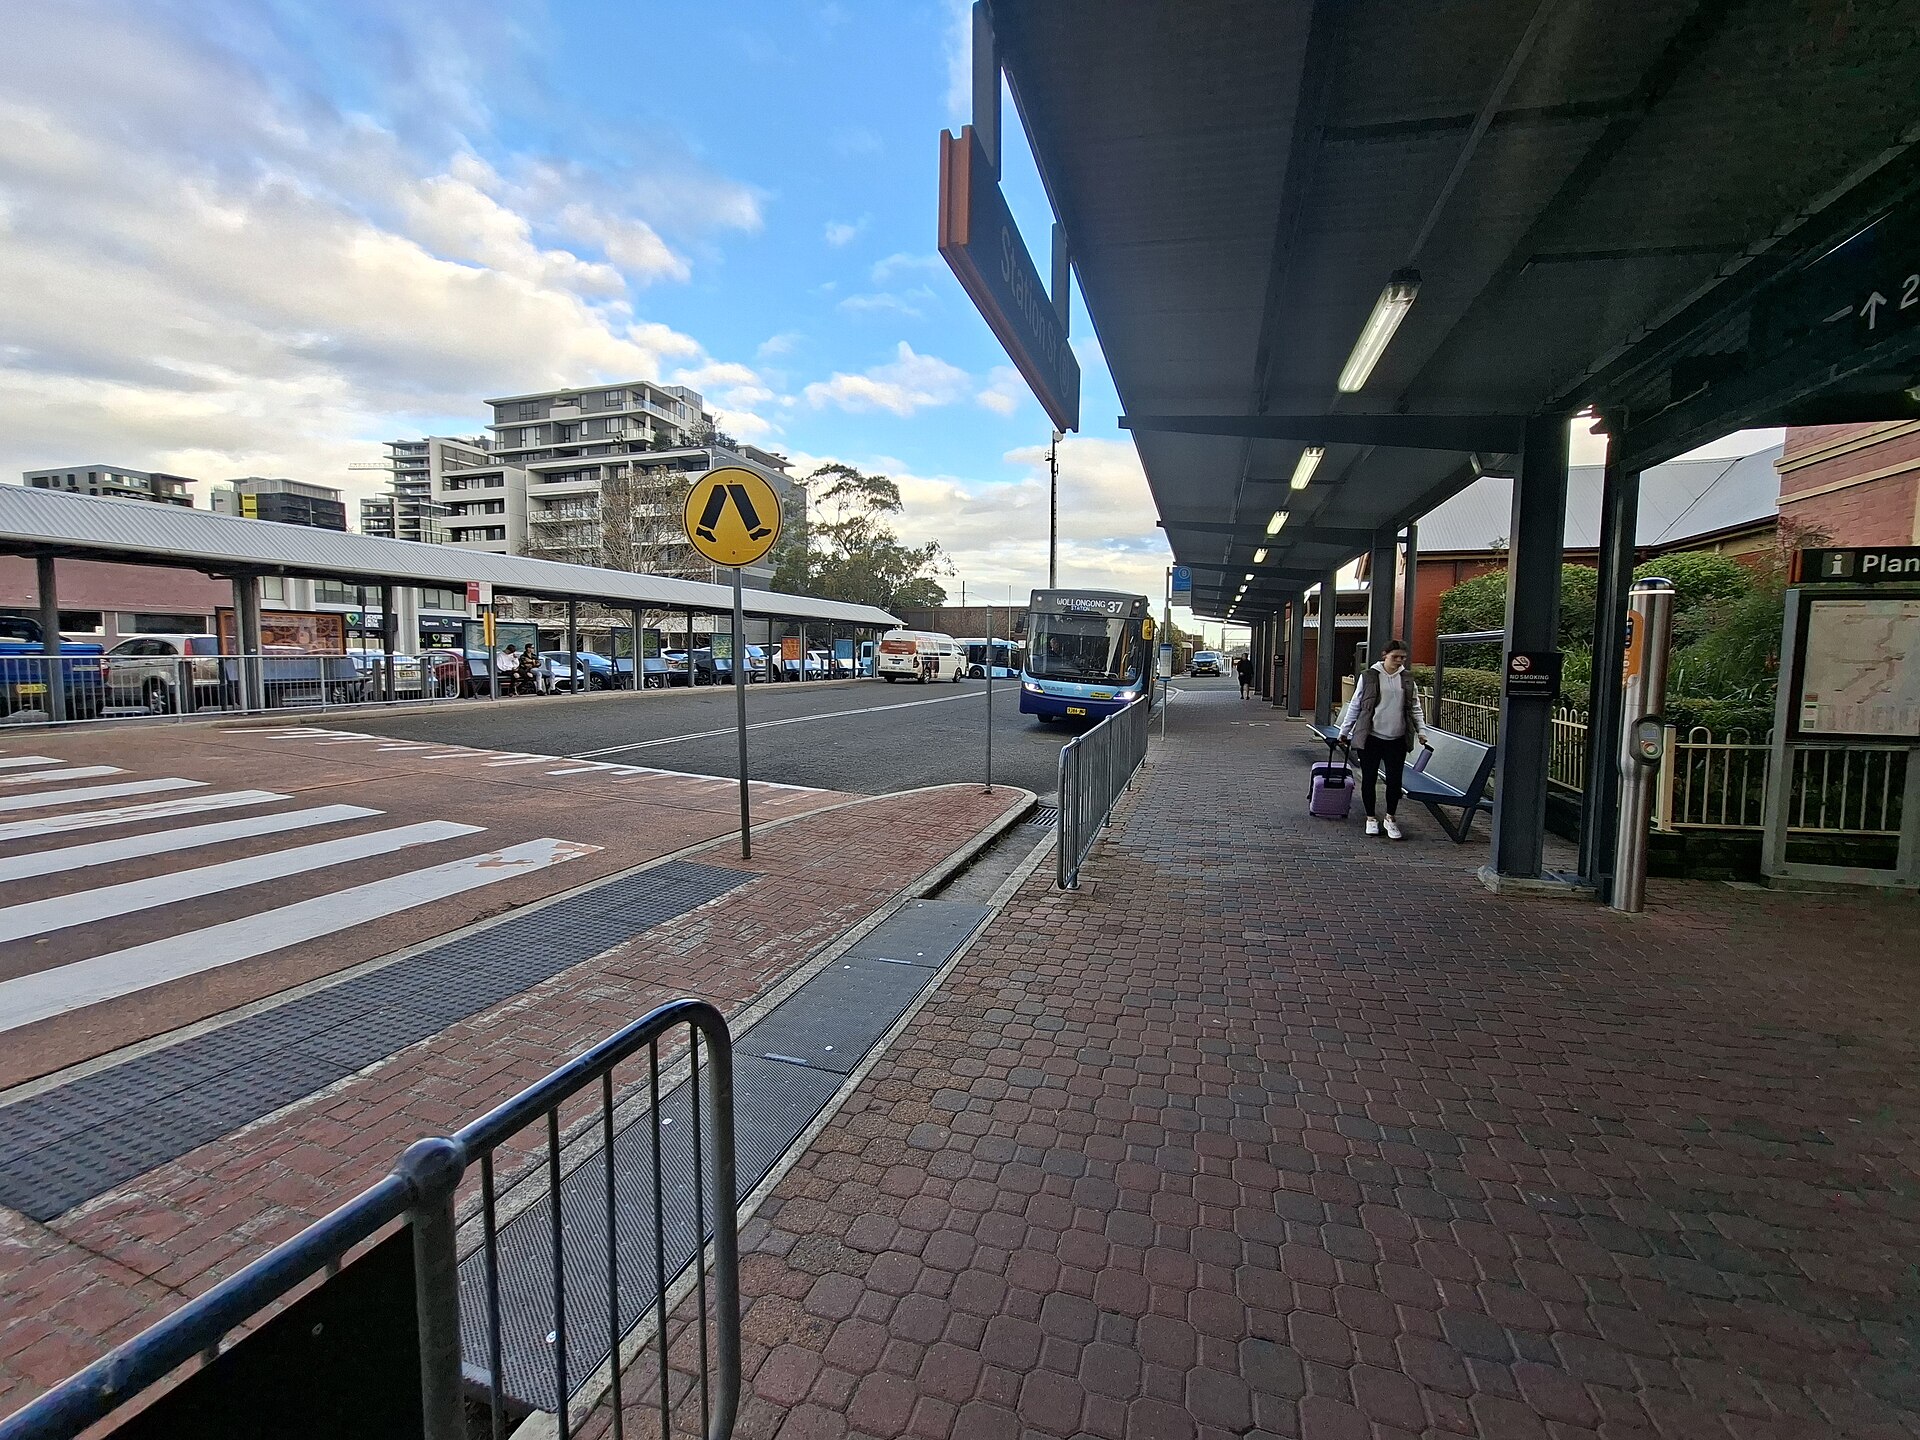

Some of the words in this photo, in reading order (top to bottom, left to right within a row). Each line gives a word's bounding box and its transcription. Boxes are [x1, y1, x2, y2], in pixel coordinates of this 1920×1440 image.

[1001, 226, 1046, 350] Station
[1048, 321, 1057, 371] St
[1862, 554, 1920, 573] Plan
[1056, 598, 1106, 608] WOLLONGONG
[1107, 601, 1123, 613] 37
